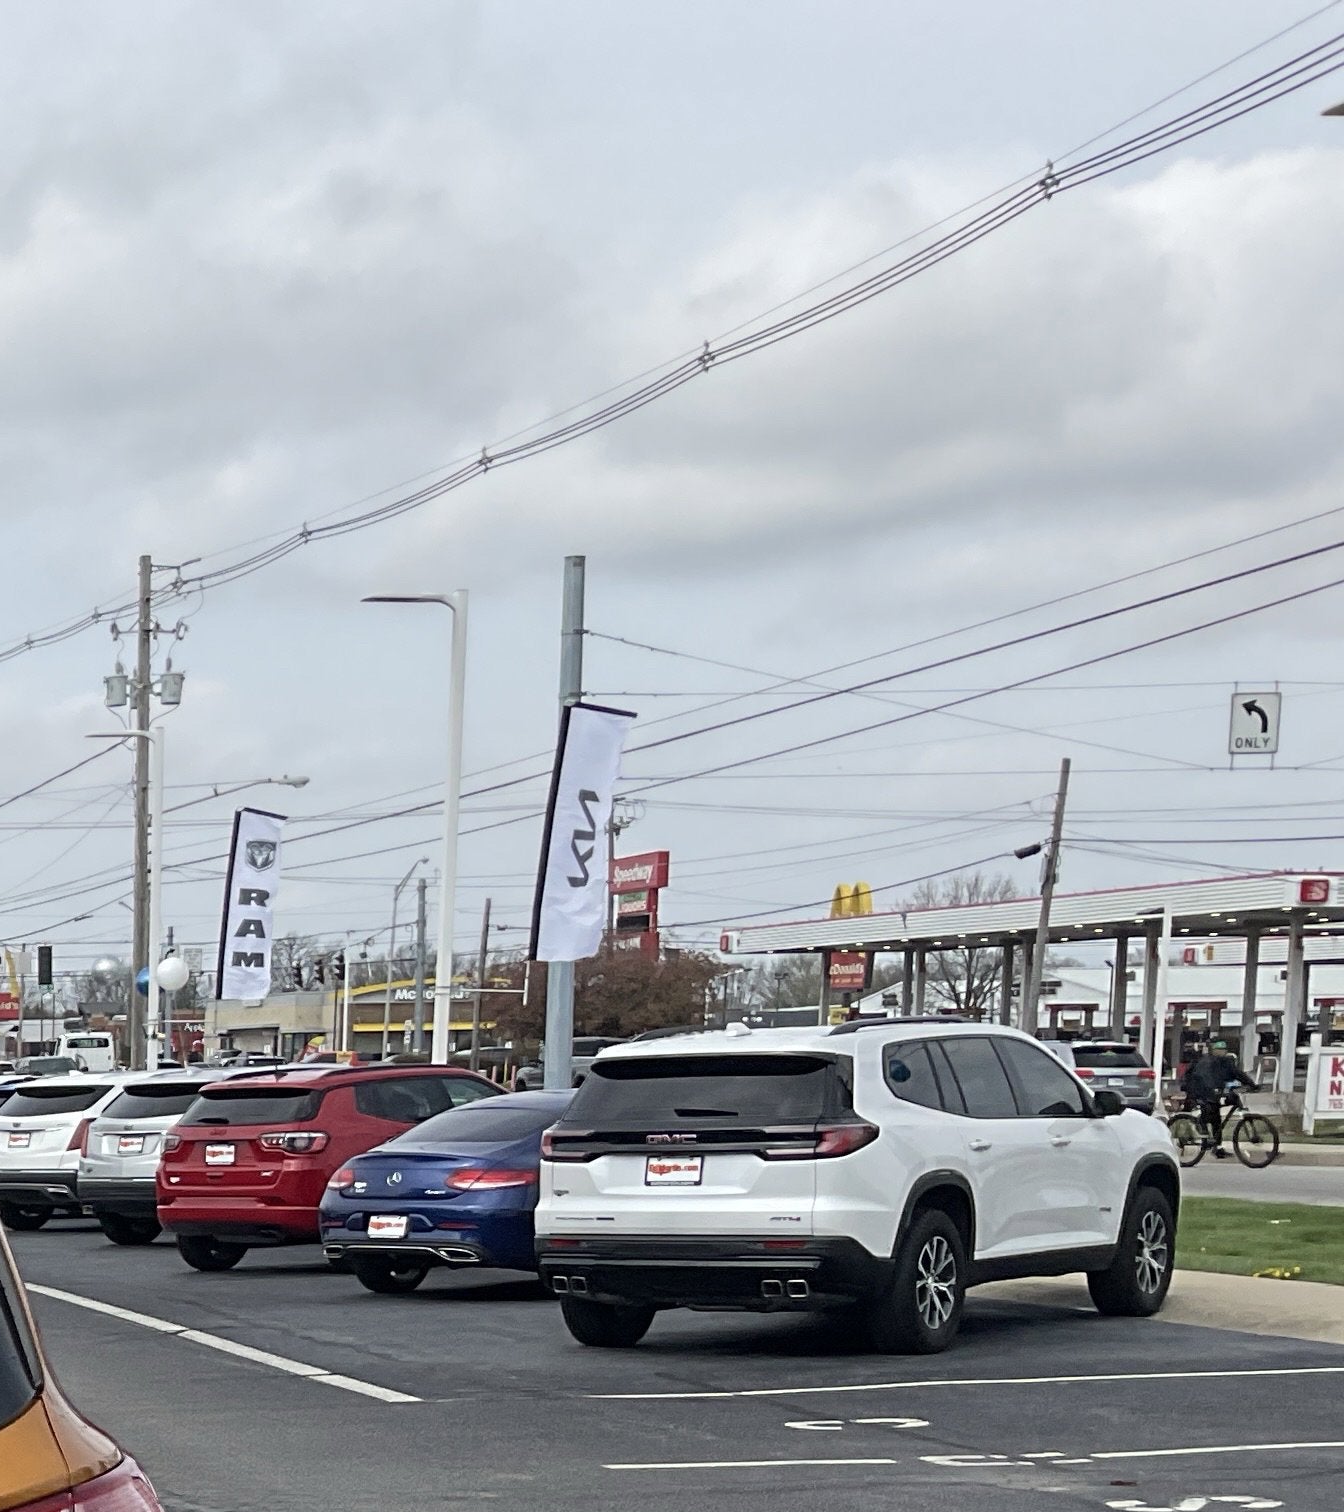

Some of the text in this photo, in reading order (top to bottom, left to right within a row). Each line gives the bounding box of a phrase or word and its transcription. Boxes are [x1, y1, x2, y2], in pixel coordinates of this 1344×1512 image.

[1235, 737, 1270, 749] ONLY
[613, 863, 653, 888] Speedway
[232, 888, 270, 967] RAM
[646, 1134, 697, 1145] GMC
